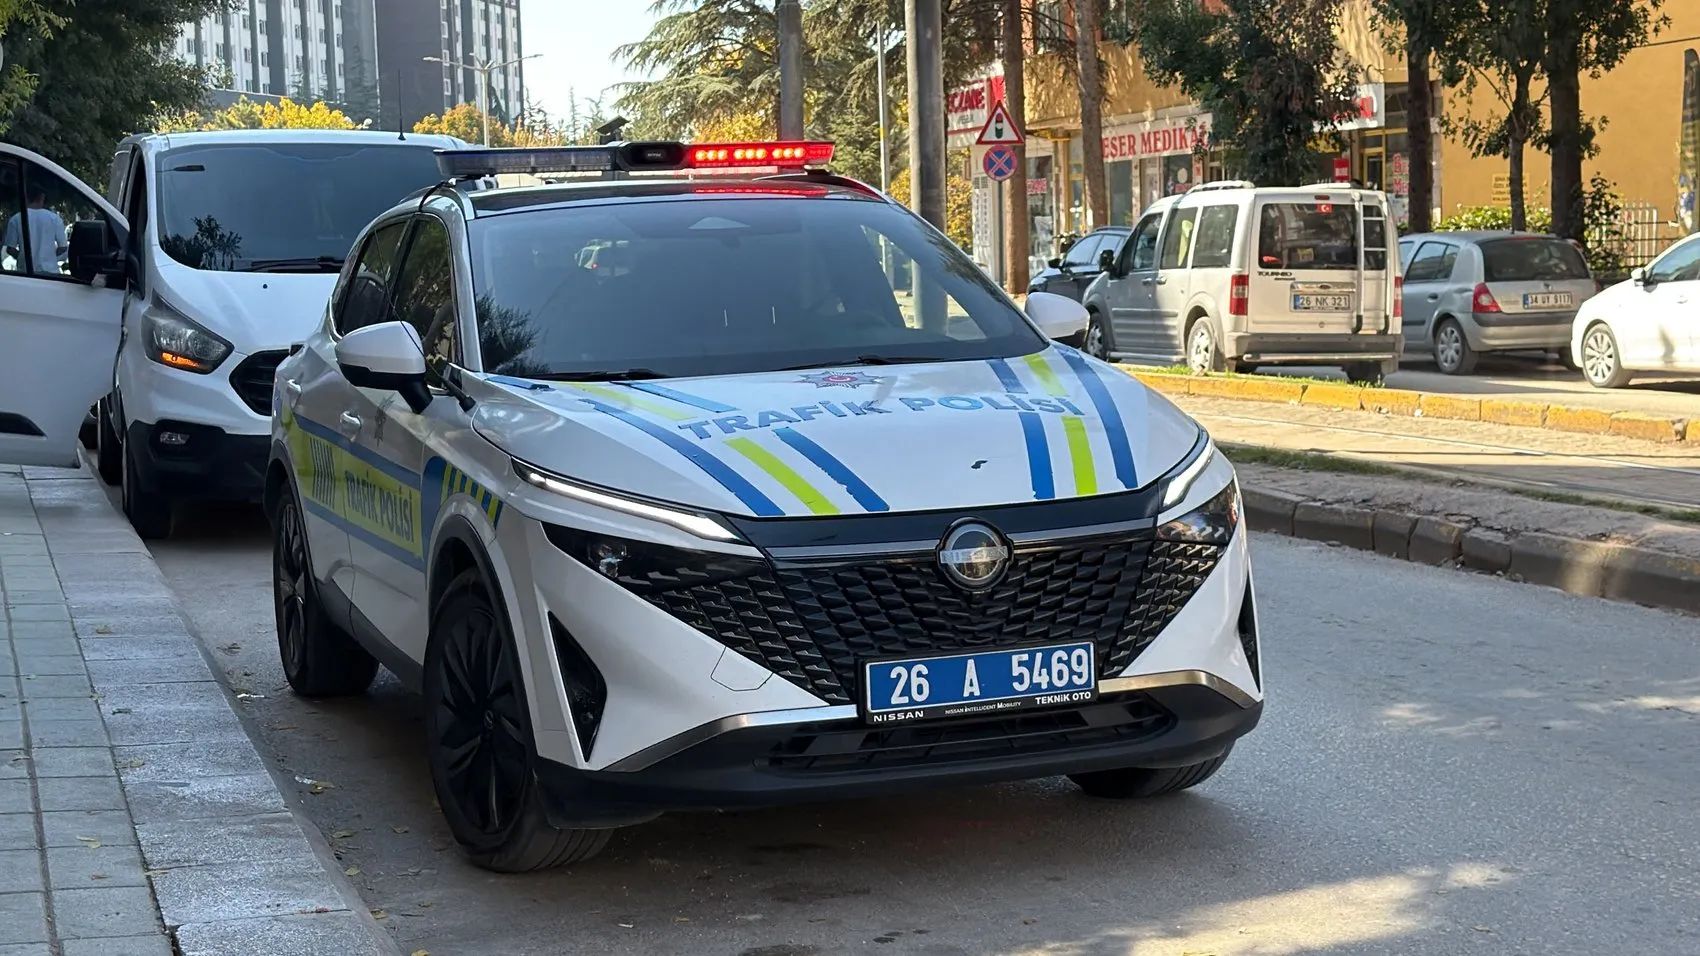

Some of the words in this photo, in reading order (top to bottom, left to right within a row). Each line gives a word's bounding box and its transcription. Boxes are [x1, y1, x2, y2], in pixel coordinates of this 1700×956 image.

[948, 87, 985, 113] CZANE
[1102, 134, 1136, 159] ESER
[1300, 296, 1311, 306] 26
[1315, 296, 1329, 306] NK
[1332, 296, 1347, 306] 321
[678, 400, 893, 439] TRAFİK
[344, 469, 378, 524] TRAFİK
[379, 484, 414, 543] POLİSİ
[890, 664, 930, 705] 26
[963, 659, 980, 697] A
[1011, 648, 1088, 692] 5469
[1072, 691, 1091, 701] OTO
[873, 710, 924, 722] NISSAN
